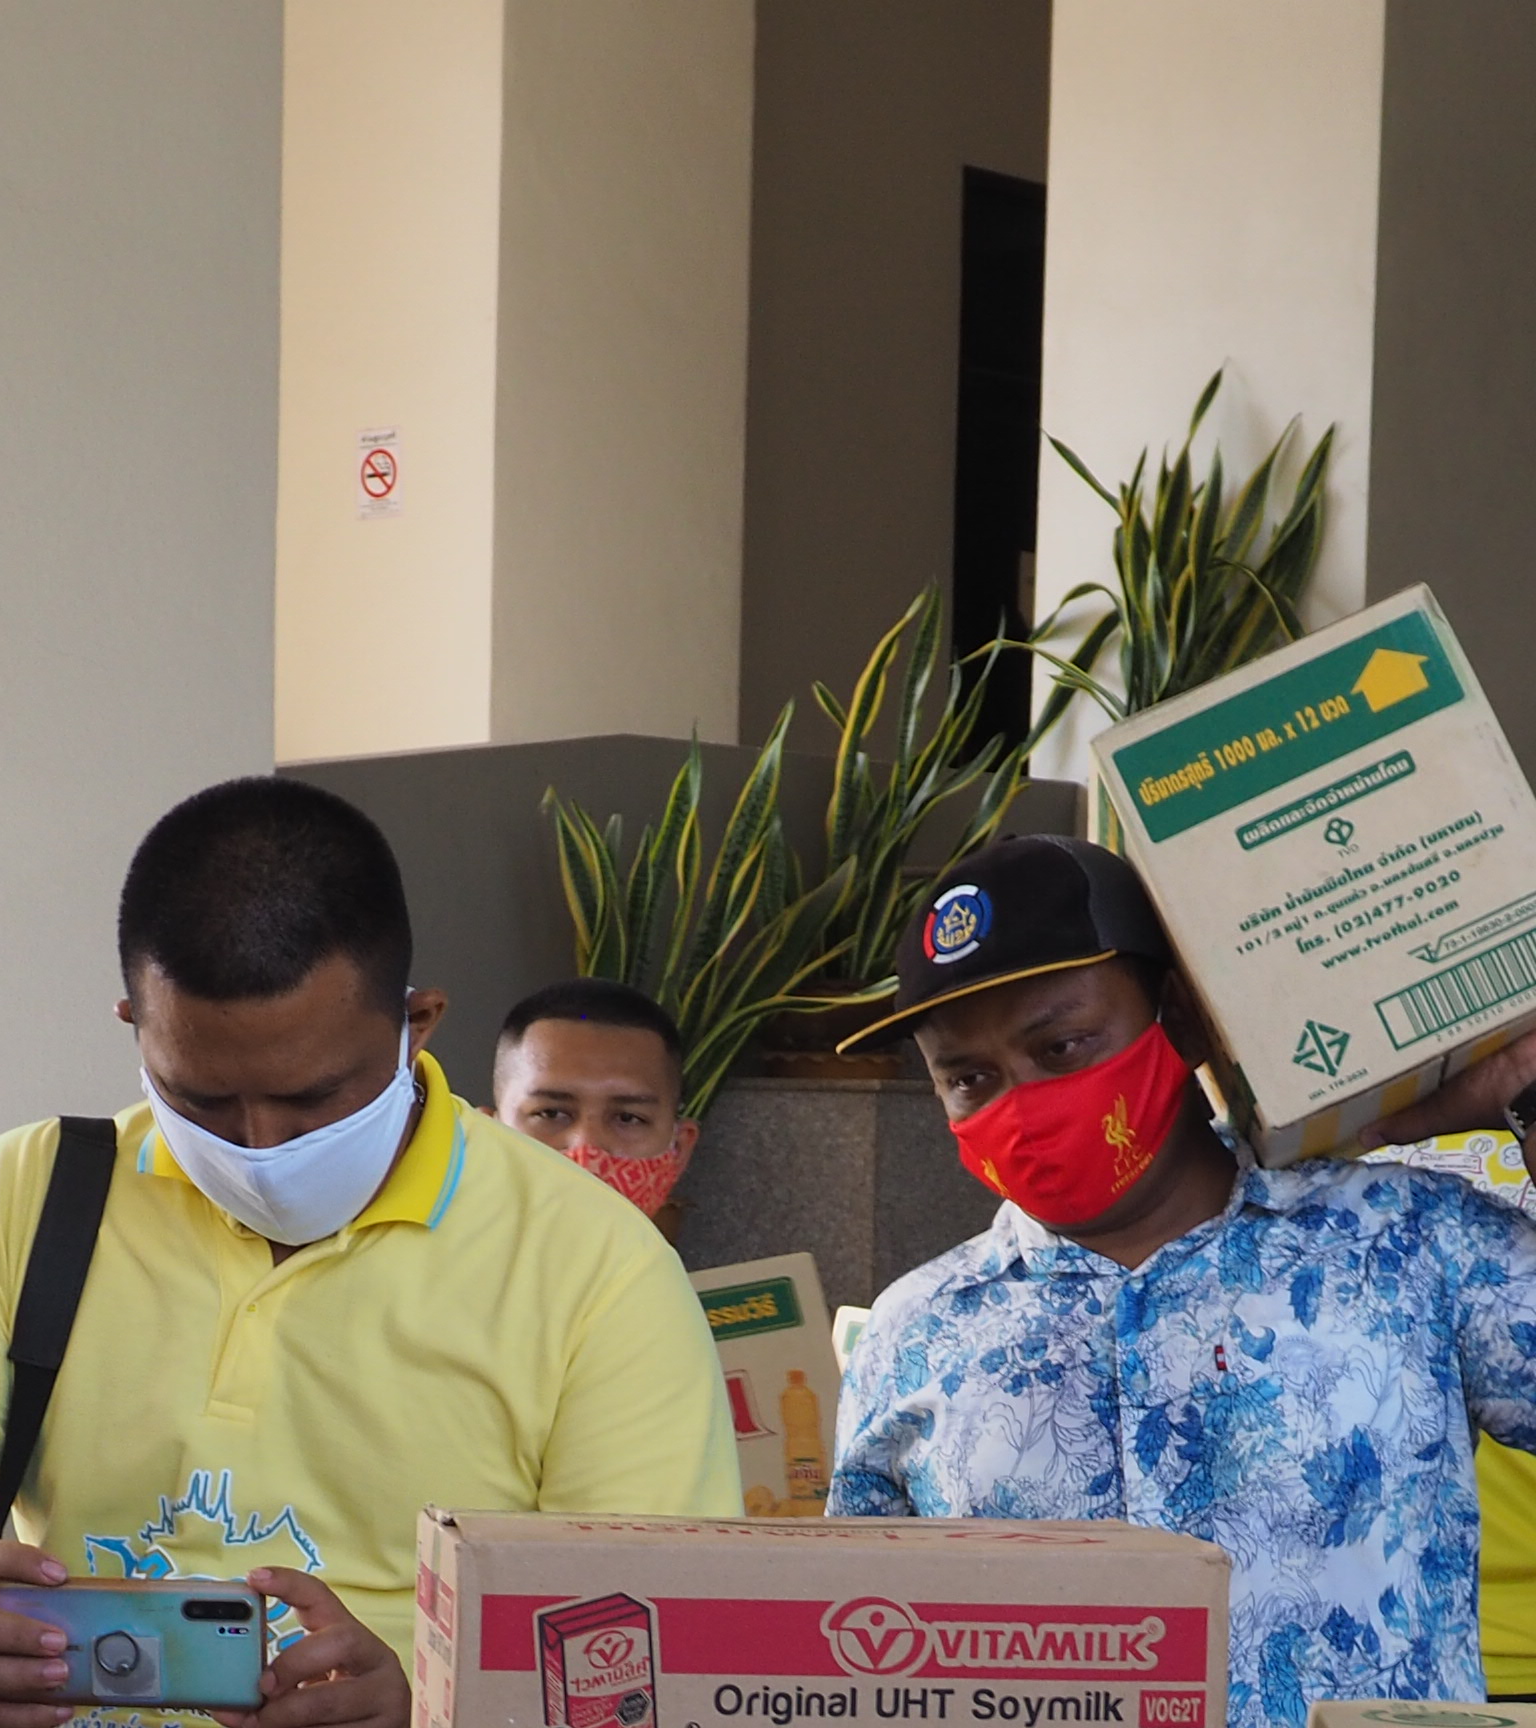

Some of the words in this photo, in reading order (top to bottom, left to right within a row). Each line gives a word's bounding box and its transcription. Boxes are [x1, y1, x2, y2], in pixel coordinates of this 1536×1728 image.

[1214, 736, 1255, 771] 1000
[1284, 722, 1297, 741] x
[1297, 708, 1320, 734] 12
[1321, 696, 1350, 724] ขวด
[1243, 757, 1409, 846] ผลิตและจัดจำหน่ายโดย
[1321, 899, 1459, 969] www.tvothai.com
[938, 1624, 1154, 1668] VITAMILK
[713, 1686, 858, 1727] Original
[875, 1688, 955, 1720] UHT
[972, 1688, 1124, 1728] Soymilk
[1144, 1695, 1202, 1724] VOG2T
